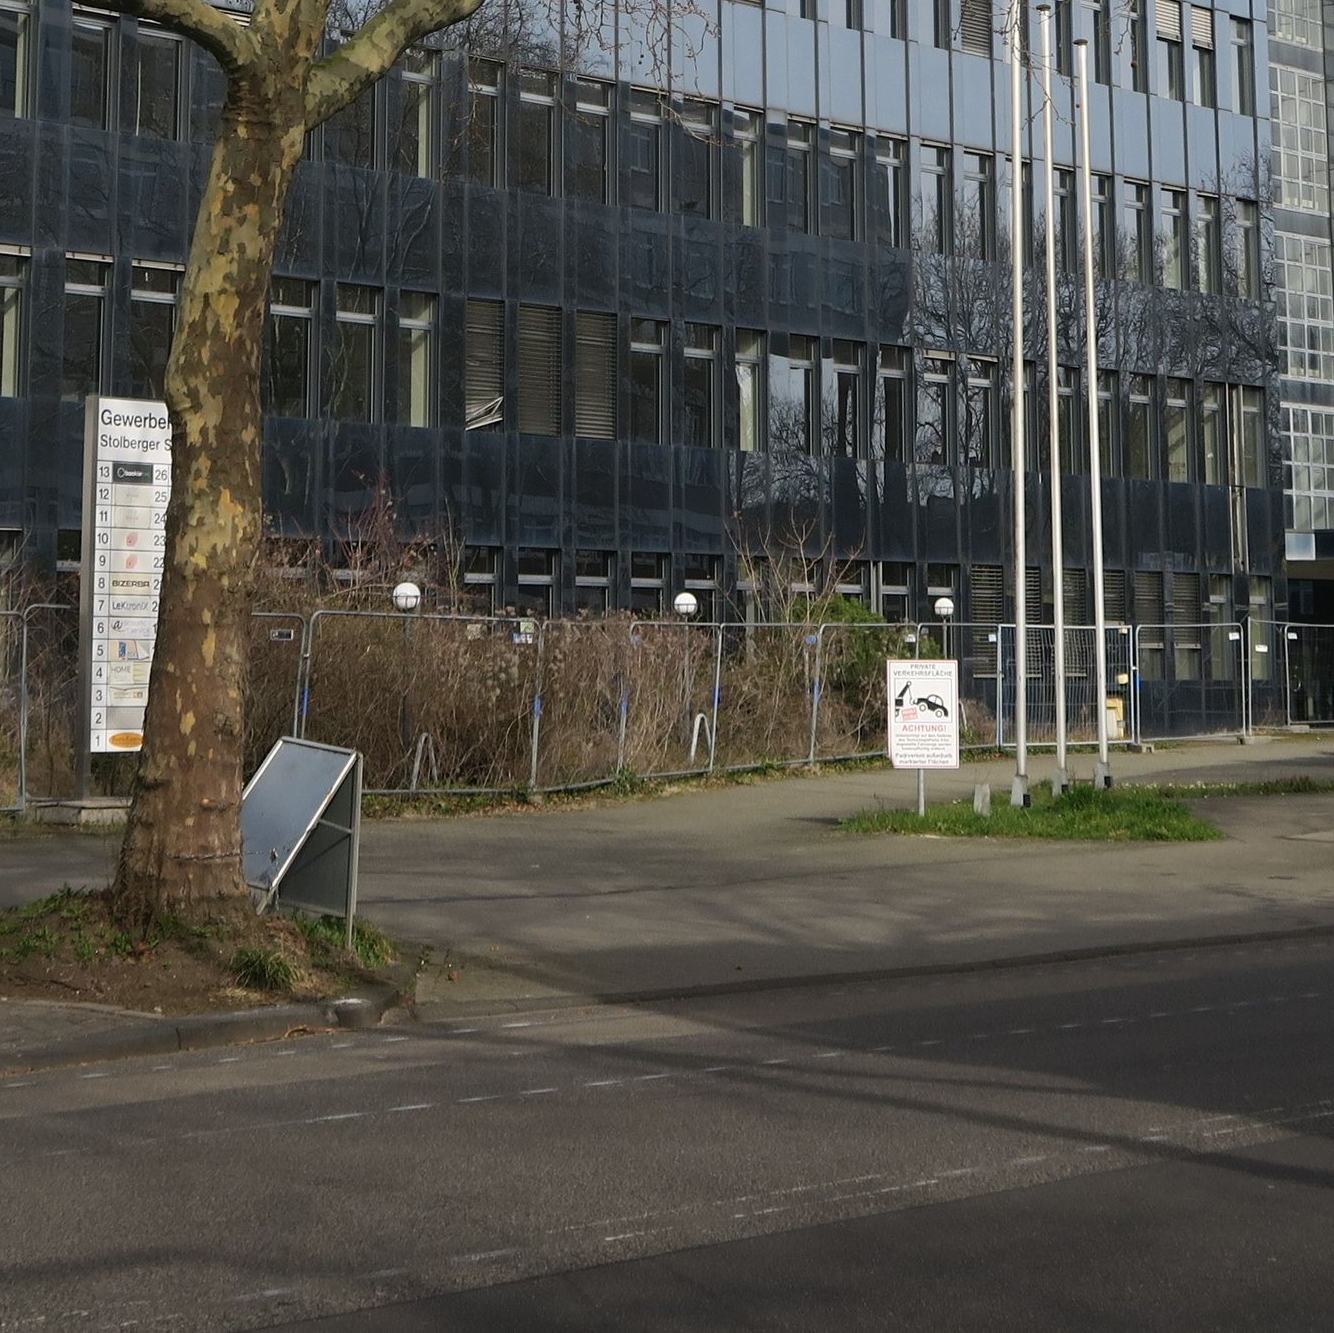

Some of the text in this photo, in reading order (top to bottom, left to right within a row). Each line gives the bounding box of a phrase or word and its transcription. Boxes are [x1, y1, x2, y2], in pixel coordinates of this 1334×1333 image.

[100, 434, 160, 452] Stolberger
[99, 466, 110, 477] 13
[155, 469, 167, 480] 26
[99, 488, 167, 502] 12 25
[99, 511, 166, 524] 11 24
[97, 532, 166, 546] 10 23
[99, 555, 106, 566] 9
[98, 578, 105, 589] 8
[98, 600, 105, 611] 7
[97, 622, 104, 633] 6
[97, 645, 104, 656] 5
[96, 667, 103, 677] 4
[95, 690, 103, 702] 3
[95, 712, 102, 724] 2
[902, 724, 947, 732] ACHTUNG!
[95, 735, 100, 746] 1
